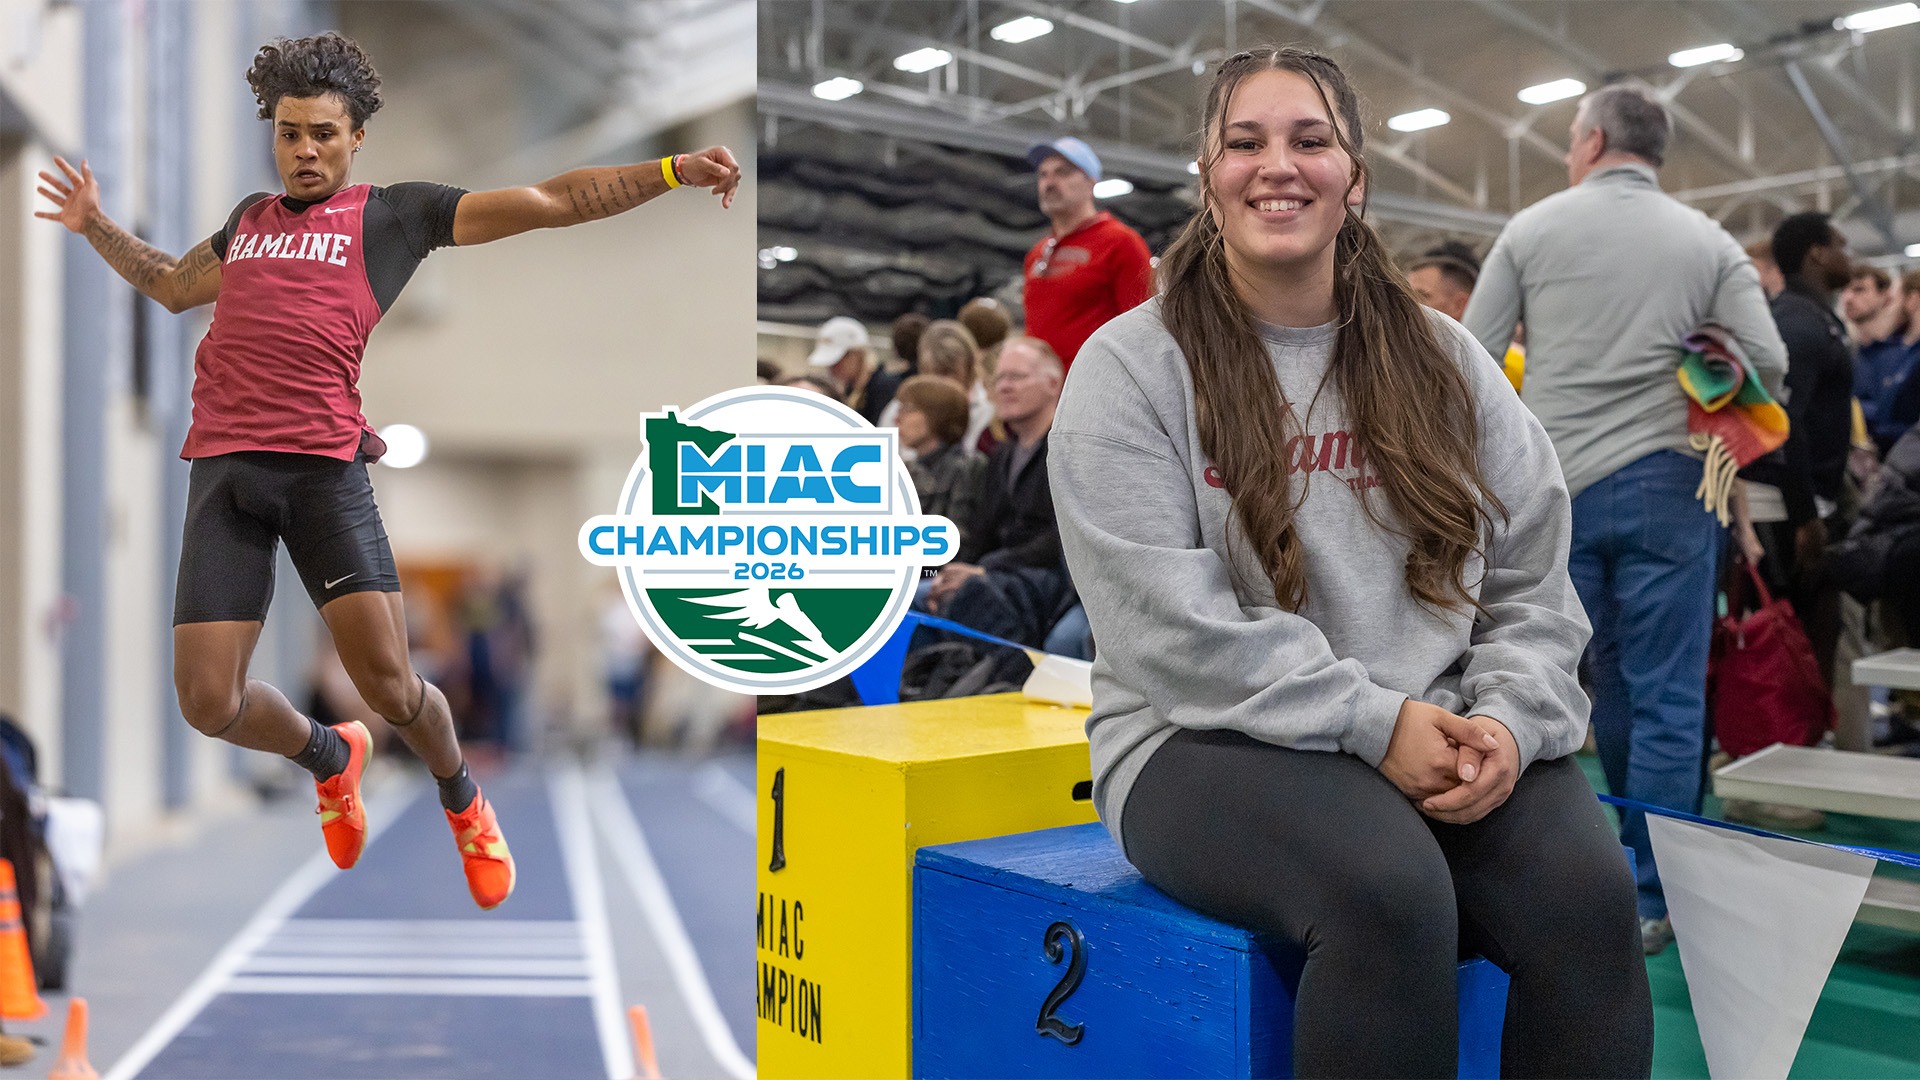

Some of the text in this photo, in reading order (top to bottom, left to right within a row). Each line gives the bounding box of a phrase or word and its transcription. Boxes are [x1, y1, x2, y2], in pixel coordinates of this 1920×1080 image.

[226, 232, 352, 267] HAMLINE
[769, 766, 786, 873] 1
[1035, 919, 1088, 1047] 2
